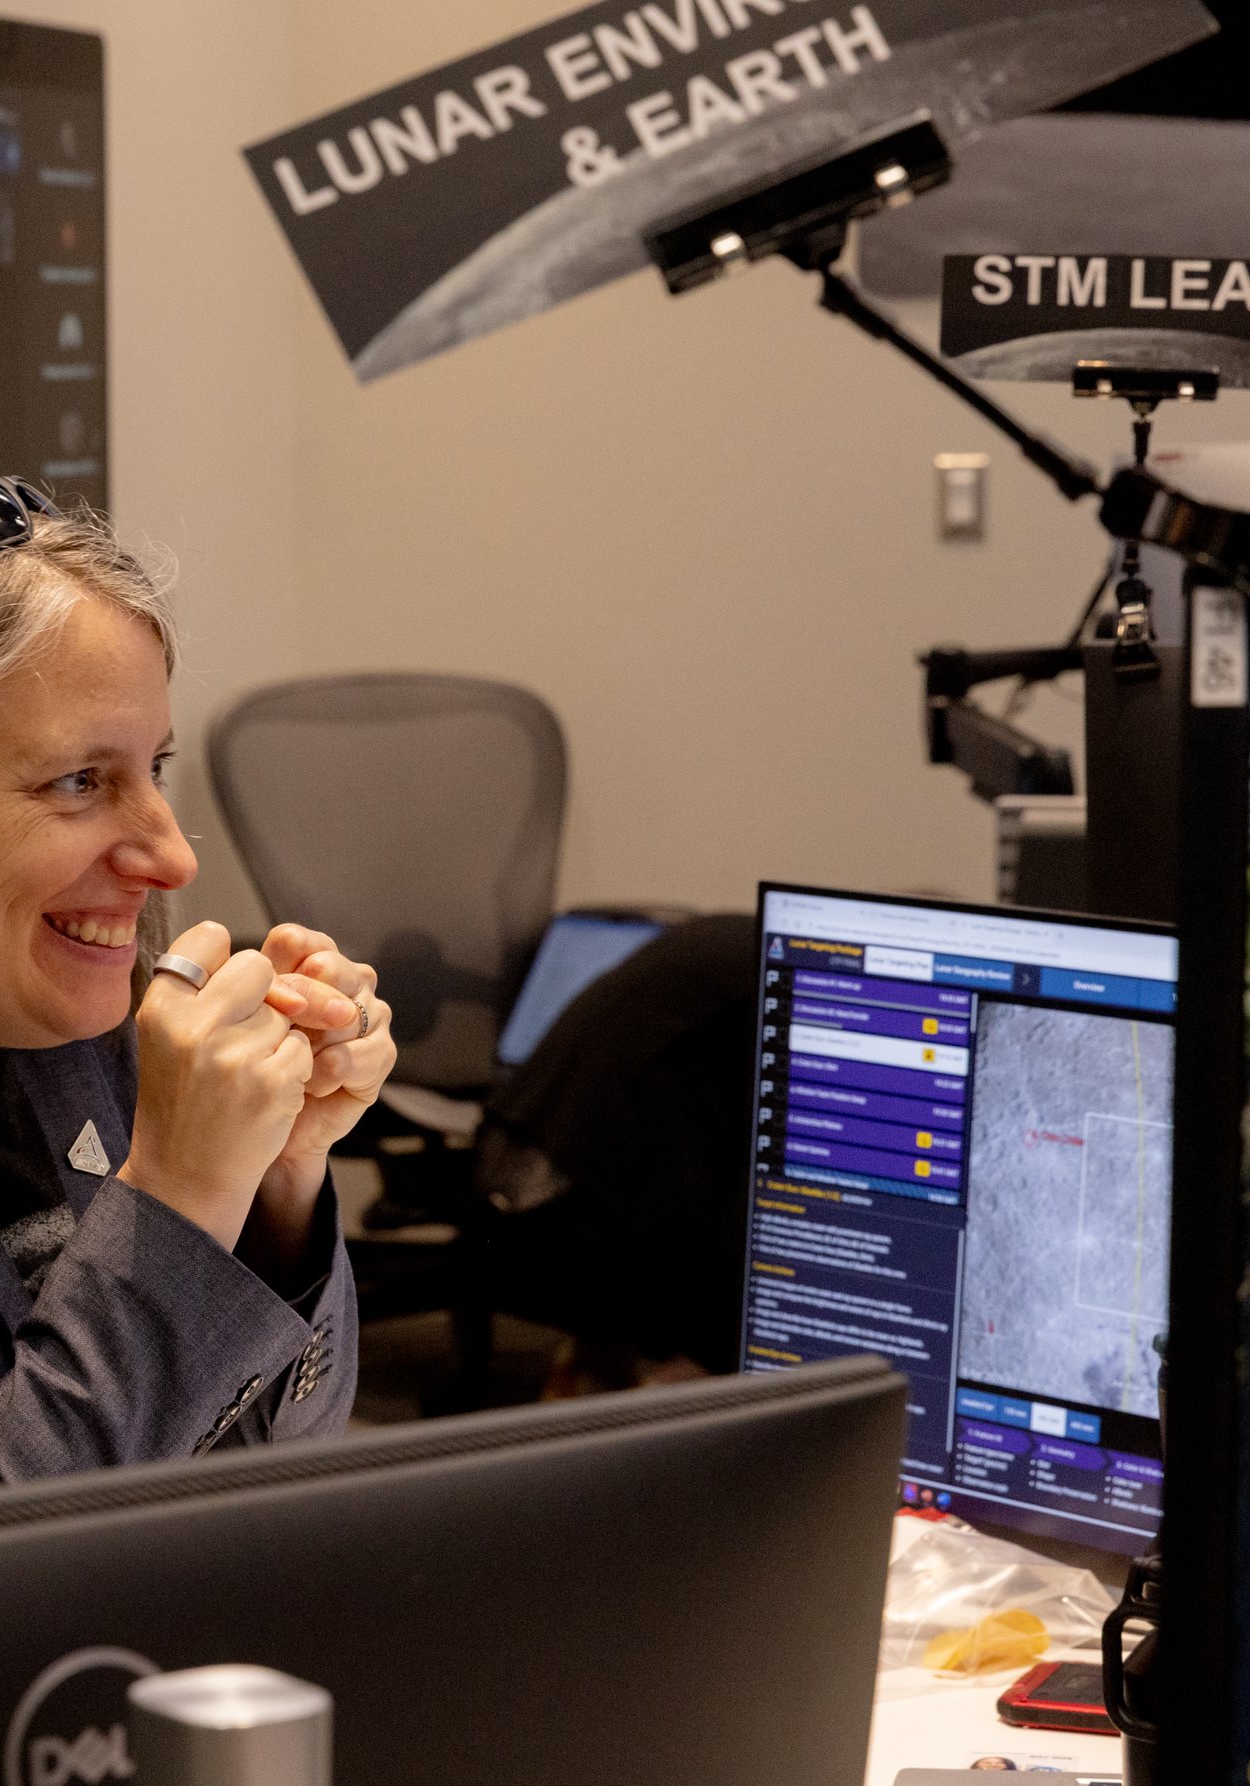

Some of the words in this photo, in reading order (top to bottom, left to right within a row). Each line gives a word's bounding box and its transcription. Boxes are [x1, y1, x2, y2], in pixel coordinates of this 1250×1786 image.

[272, 64, 547, 215] LUNAR
[544, 0, 787, 102] ENVI
[560, 125, 624, 187] &
[625, 5, 891, 157] EARTH
[971, 254, 1108, 307] STM
[1129, 258, 1250, 311] LEA
[30, 1721, 137, 1786] DEL
